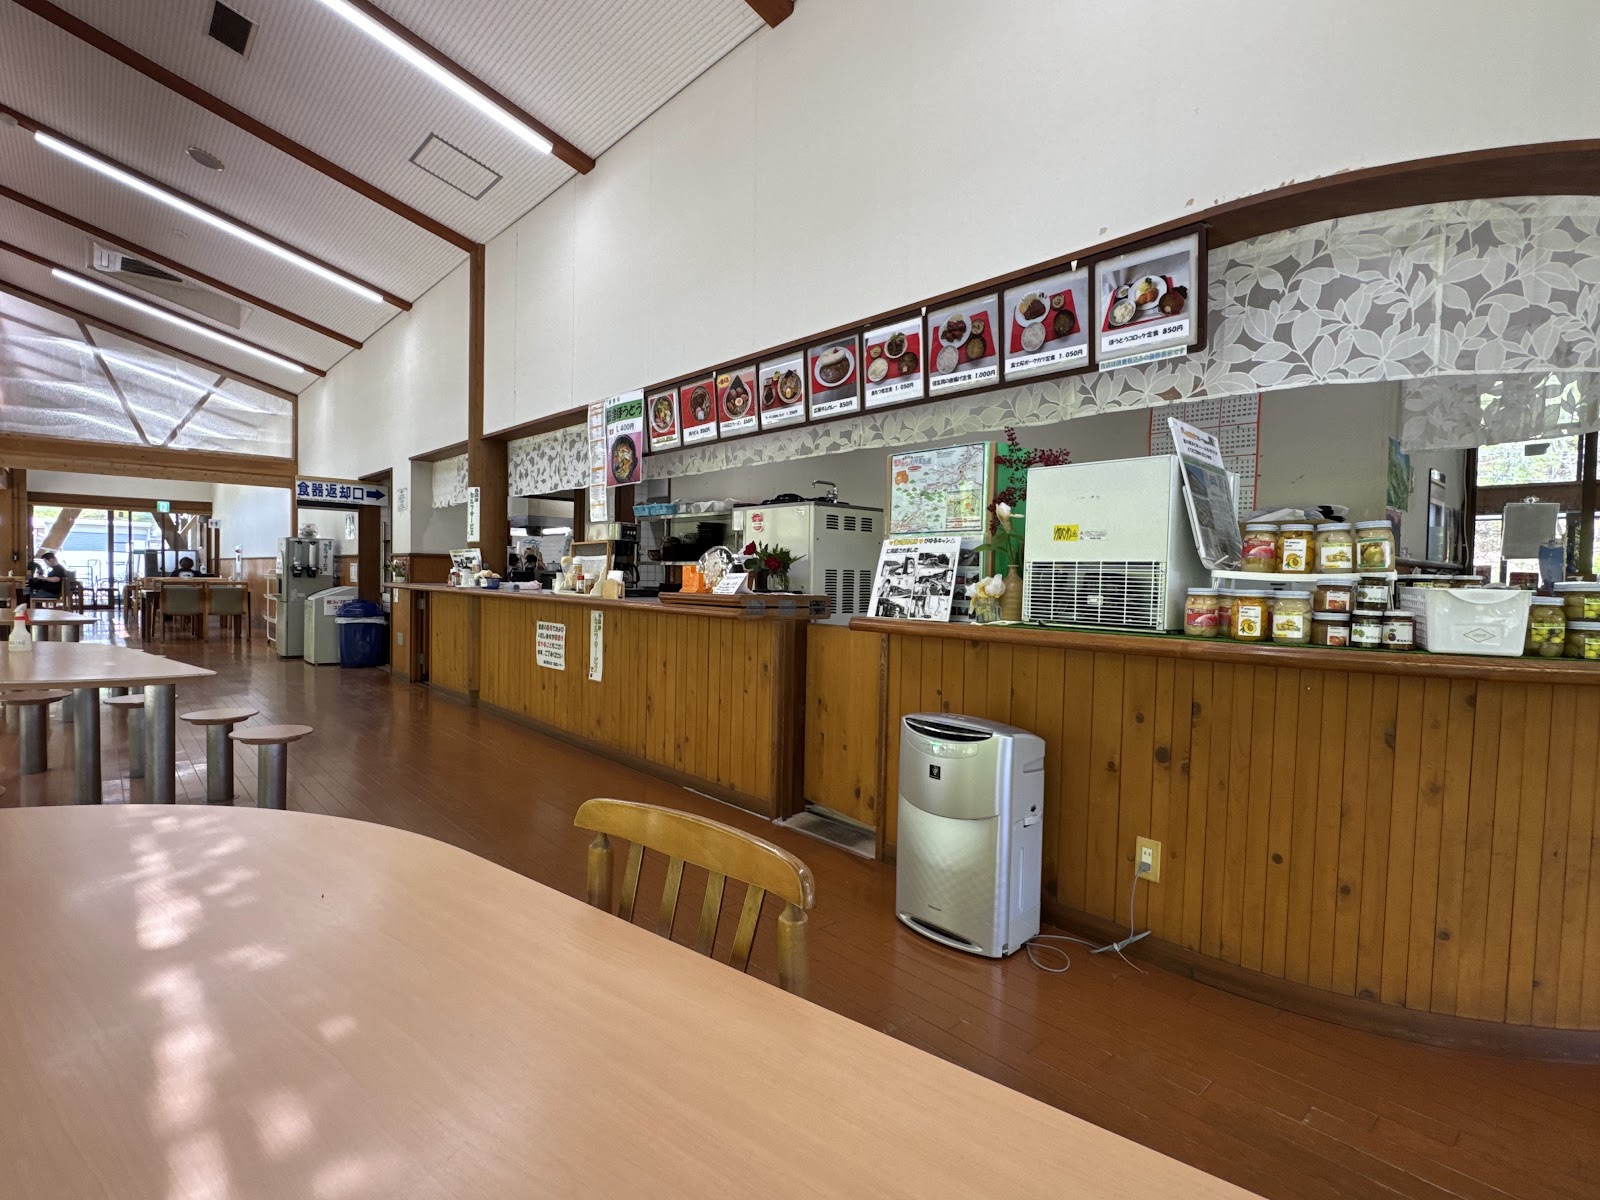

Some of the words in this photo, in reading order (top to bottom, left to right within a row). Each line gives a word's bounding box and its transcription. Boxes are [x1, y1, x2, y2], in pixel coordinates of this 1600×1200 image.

[1162, 324, 1183, 334] 850円
[297, 482, 364, 500] 食器返却口
